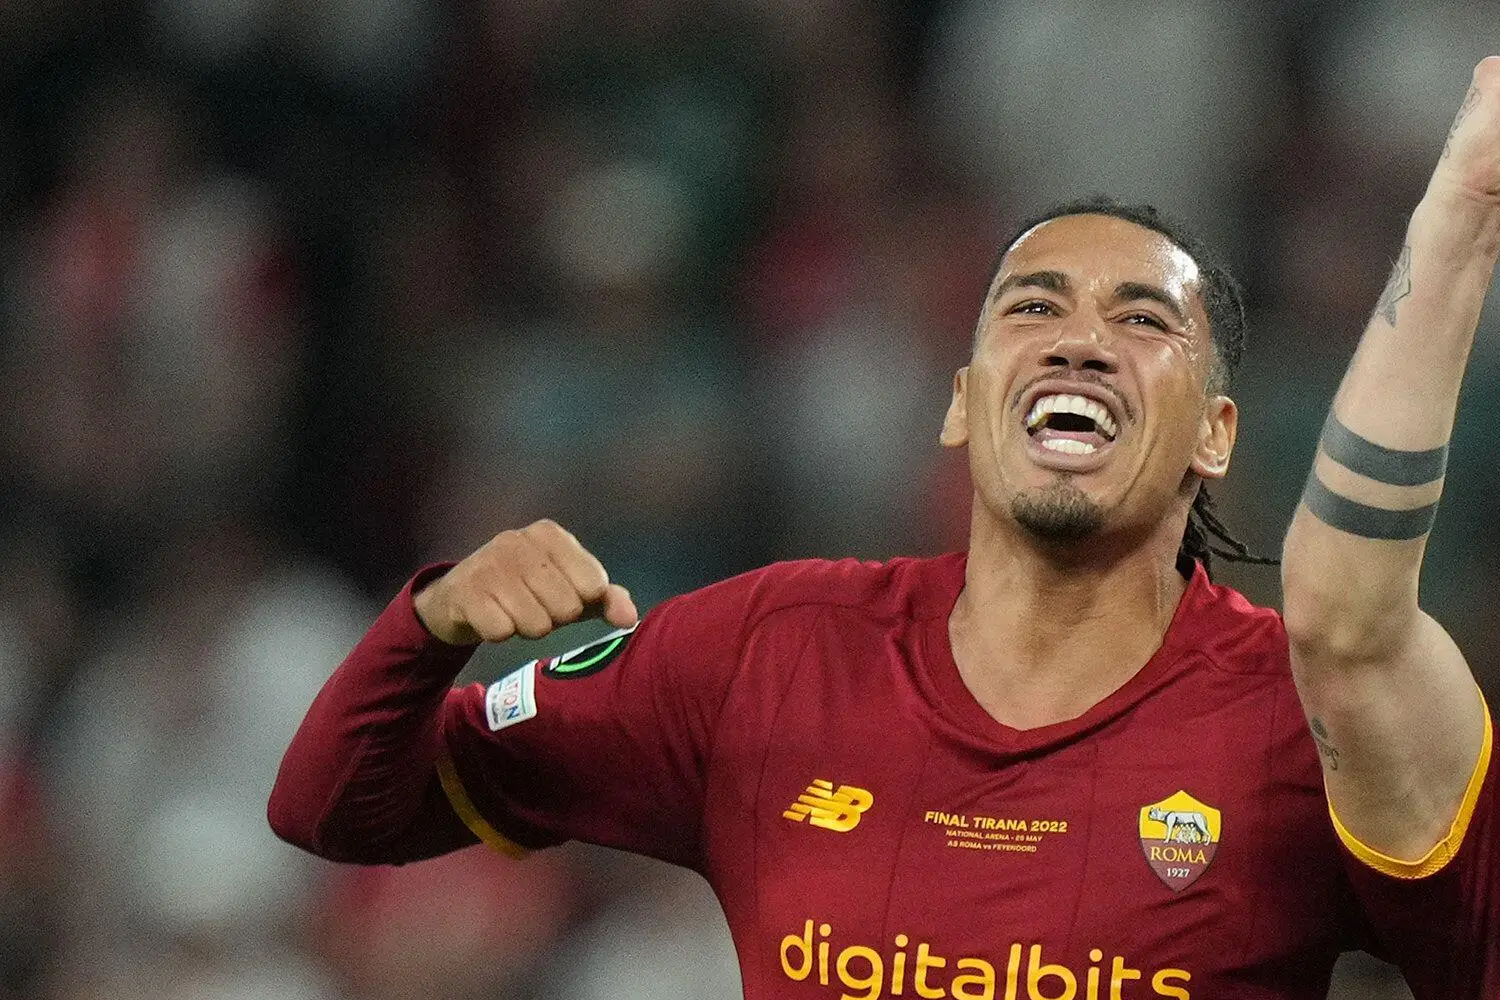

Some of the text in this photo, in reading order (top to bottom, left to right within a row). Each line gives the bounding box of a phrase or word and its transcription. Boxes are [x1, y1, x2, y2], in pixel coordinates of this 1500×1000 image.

[925, 811, 1068, 833] FINAL TIRANA 2022
[946, 829, 984, 840] NATIONAL
[985, 833, 1010, 841] ARENA
[947, 840, 959, 848] AS
[959, 841, 982, 849] ROMA
[992, 844, 1037, 853] FEYENOORD
[1150, 846, 1207, 864] ROMA
[1166, 867, 1190, 878] 1927
